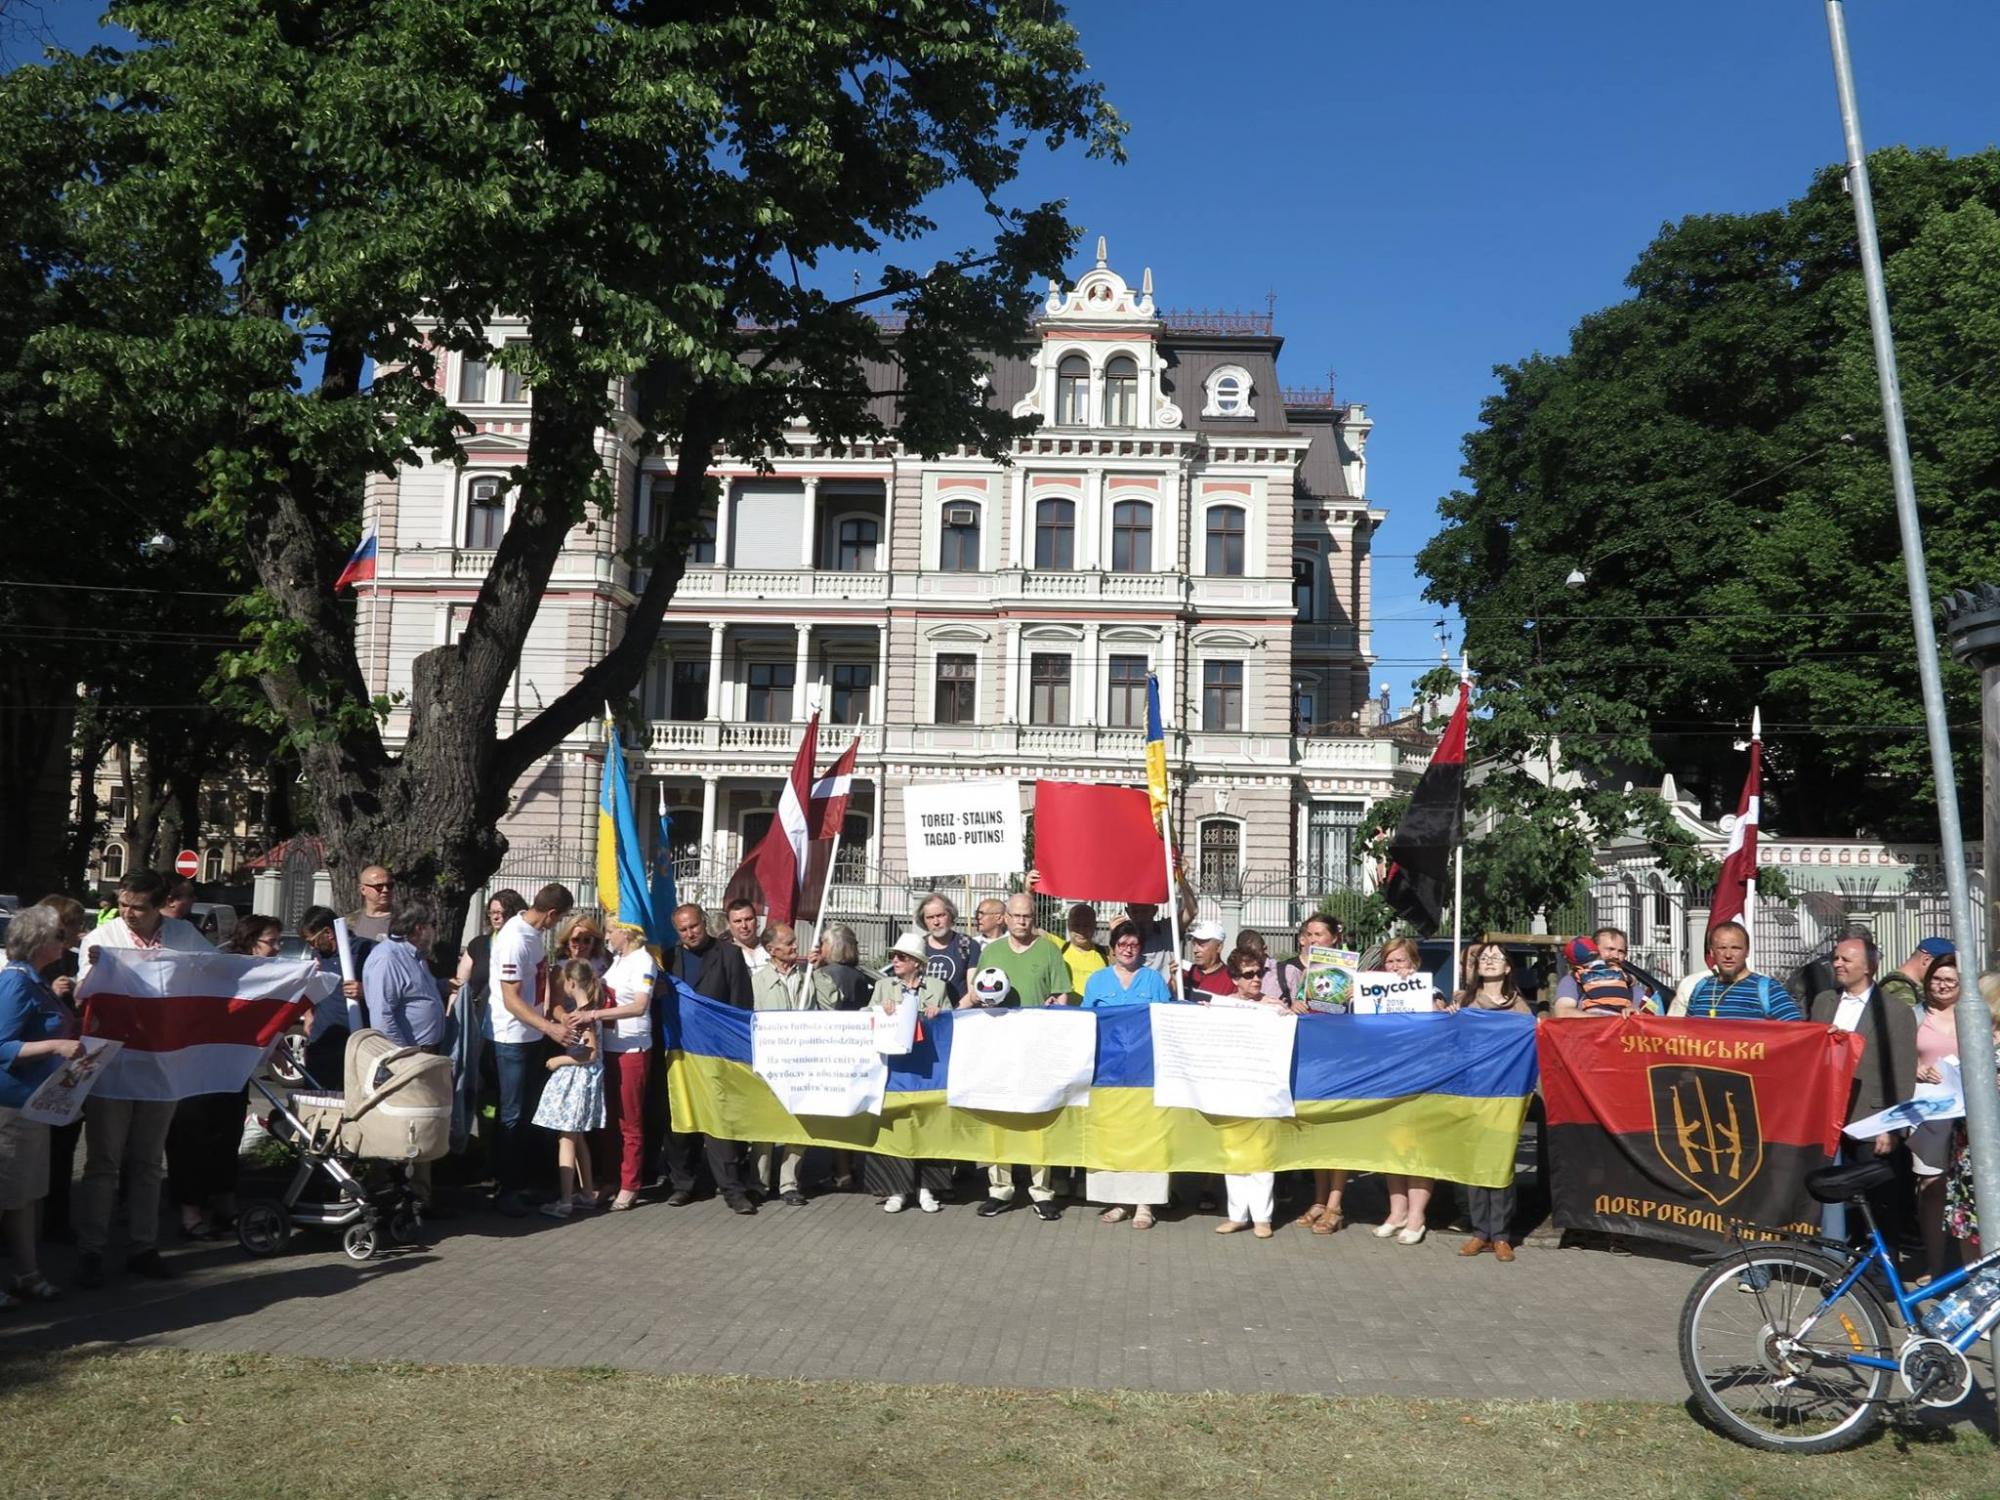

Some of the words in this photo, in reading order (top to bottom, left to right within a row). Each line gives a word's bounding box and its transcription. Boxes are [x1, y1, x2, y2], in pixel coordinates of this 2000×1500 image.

[921, 813, 955, 827] TOREIZ
[924, 832, 956, 846] TAGAD
[964, 829, 1004, 844] PUTINS!
[1360, 978, 1427, 998] boycott.
[1620, 1035, 1765, 1060] УКРАЇНСЬКА
